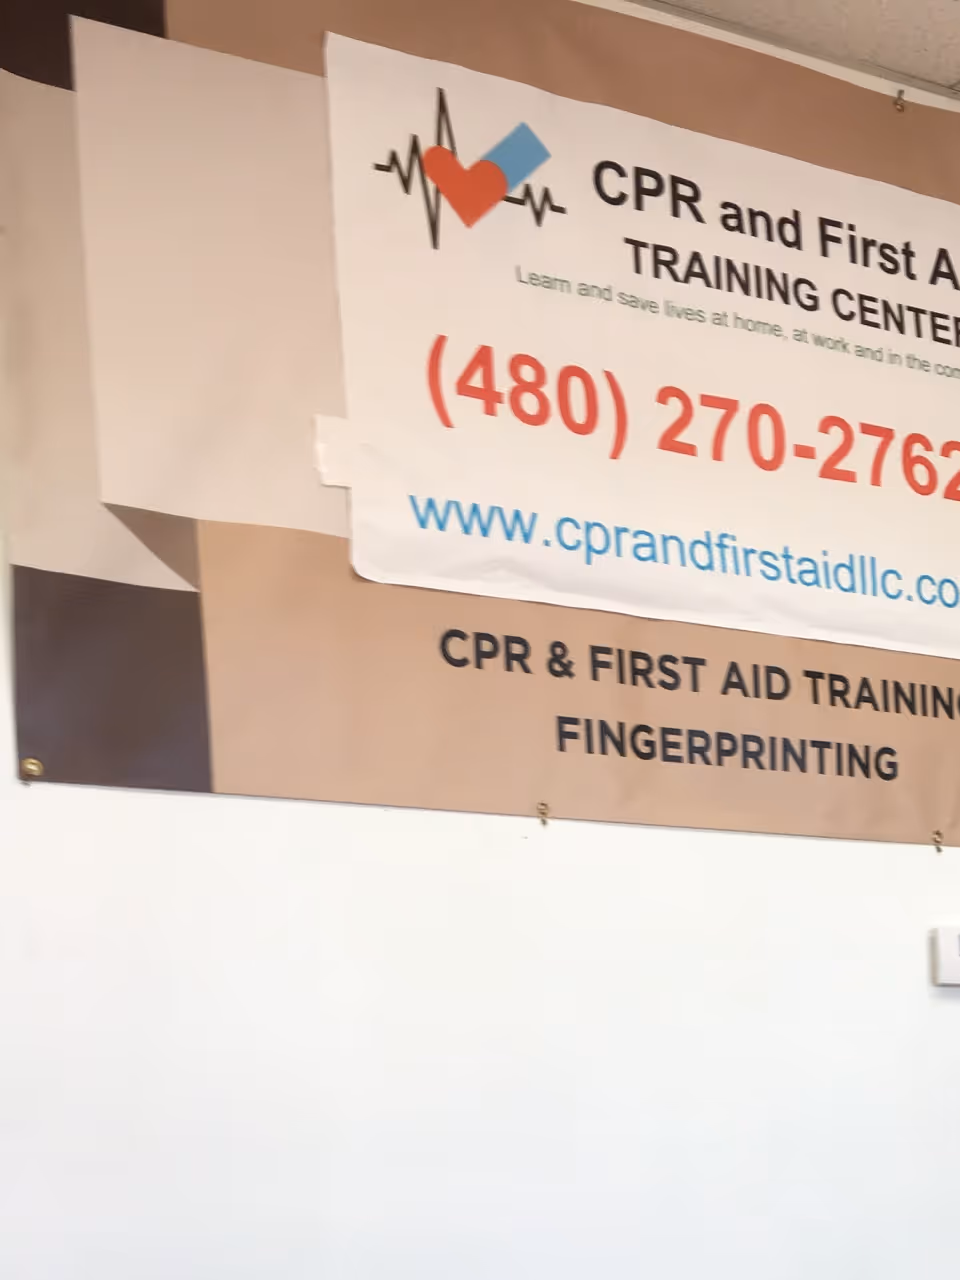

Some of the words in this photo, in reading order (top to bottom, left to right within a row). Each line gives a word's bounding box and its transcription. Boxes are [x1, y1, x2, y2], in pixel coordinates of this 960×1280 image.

[593, 160, 706, 224] CPR
[719, 201, 803, 251] and
[818, 216, 917, 281] First
[515, 265, 573, 295] Learn
[576, 283, 614, 302] and
[617, 291, 660, 315] save
[663, 299, 707, 323] lives
[711, 310, 730, 328] at
[733, 312, 789, 341] home,
[792, 328, 809, 344] at
[811, 333, 852, 354] work
[854, 343, 884, 363] and
[886, 349, 903, 367] in
[905, 353, 932, 373] the
[624, 237, 820, 312] TRAINING
[427, 334, 628, 460] (480)
[439, 628, 532, 674] CPR
[547, 640, 575, 679] &
[589, 644, 706, 693] FIRST
[721, 661, 791, 701] AID
[556, 715, 899, 782] FINGERPRINTING
